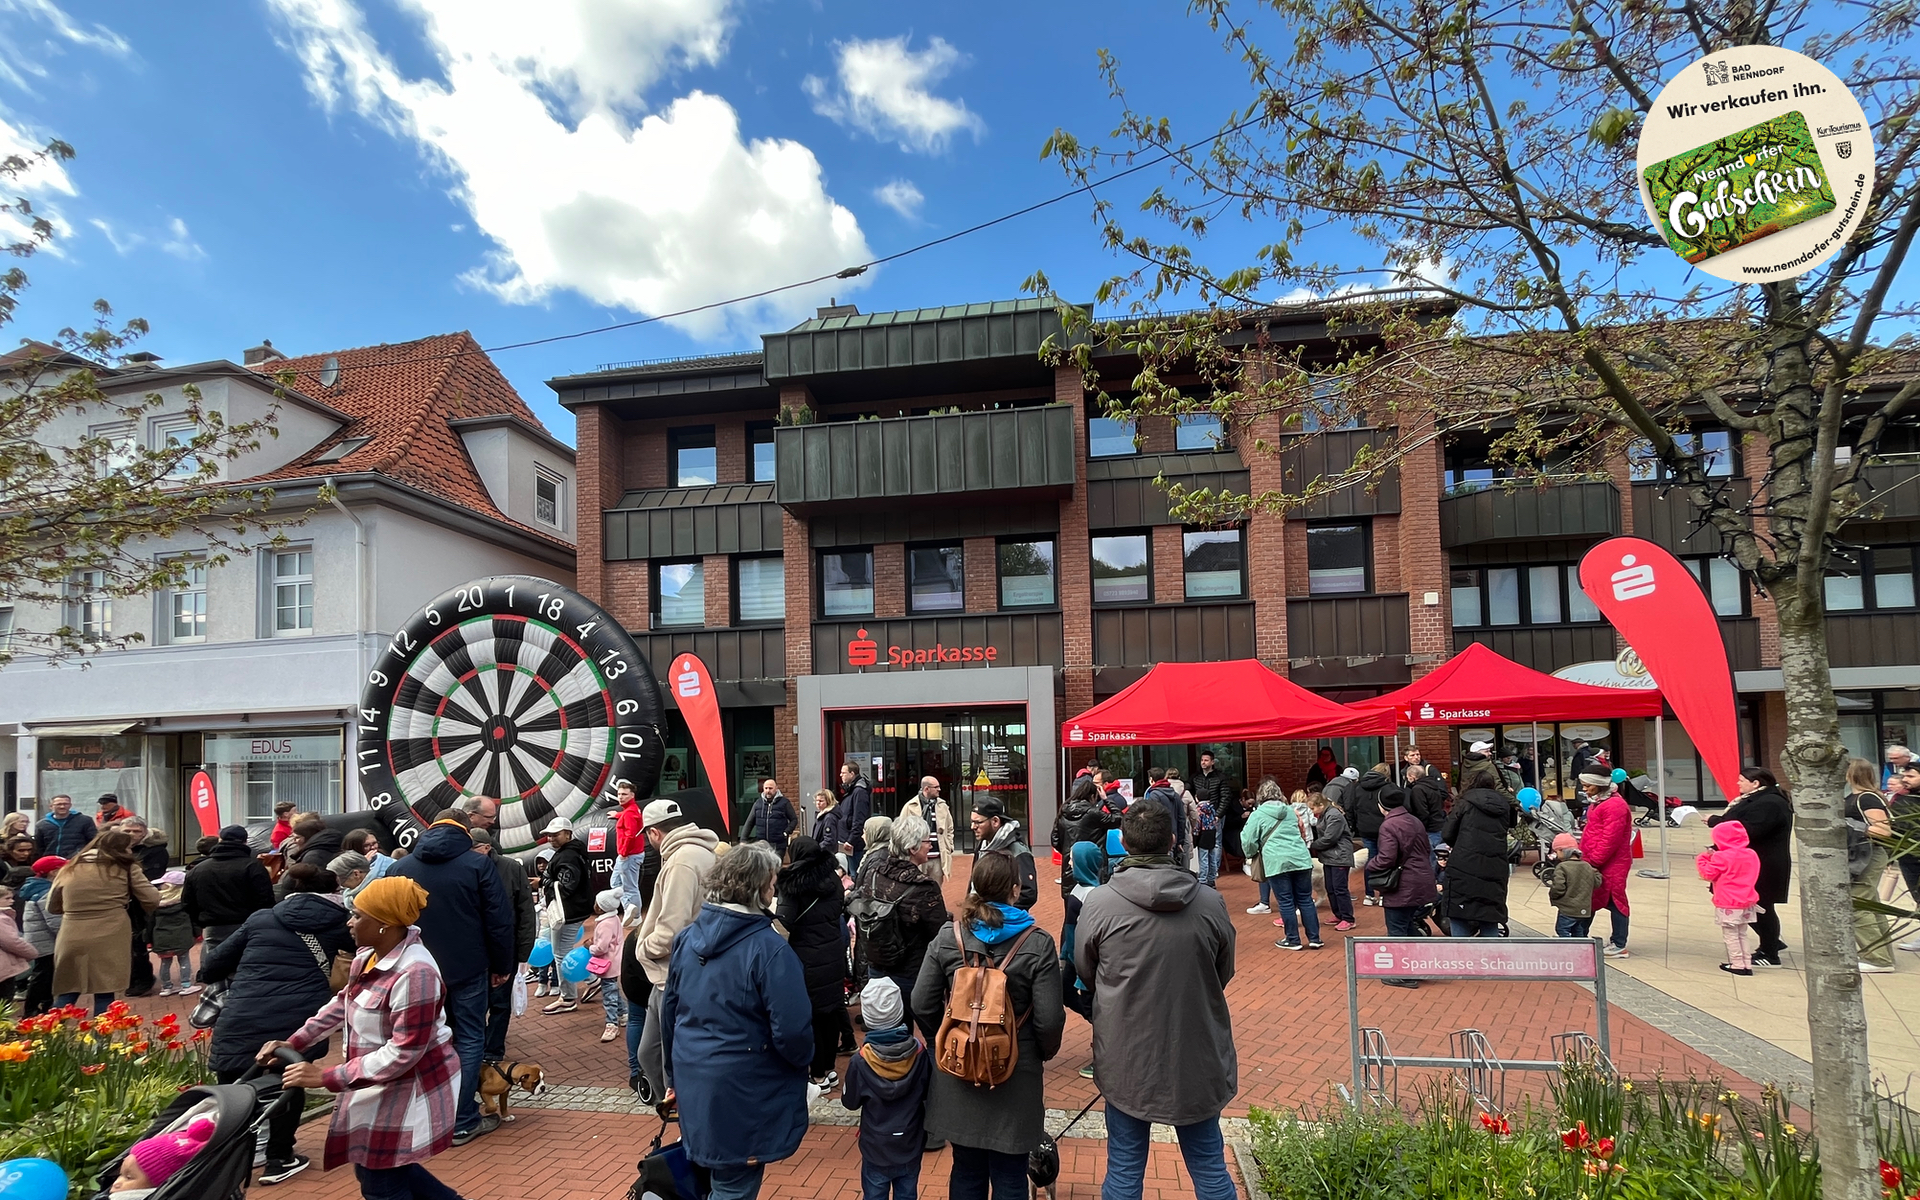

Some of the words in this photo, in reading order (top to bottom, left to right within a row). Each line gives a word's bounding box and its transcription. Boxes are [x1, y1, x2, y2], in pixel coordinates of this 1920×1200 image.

[455, 585, 484, 613] 20
[504, 584, 516, 608] 1
[537, 592, 565, 621] 18
[424, 602, 442, 627] 5
[576, 619, 596, 640] 4
[388, 629, 418, 659] 12
[888, 643, 997, 668] Sparkasse
[598, 648, 628, 681] 13
[368, 669, 389, 688] 9
[616, 699, 639, 716] 6
[1439, 708, 1491, 720] Sparkasse
[359, 707, 381, 736] 14
[251, 739, 292, 754] EDUS
[618, 732, 644, 762] 10
[1087, 731, 1137, 743] Sparkasse
[359, 747, 382, 776] 11
[370, 792, 392, 811] 8
[392, 816, 419, 849] 16
[1401, 957, 1474, 971] Sparkasse
[1480, 957, 1575, 974] Schaumburg
